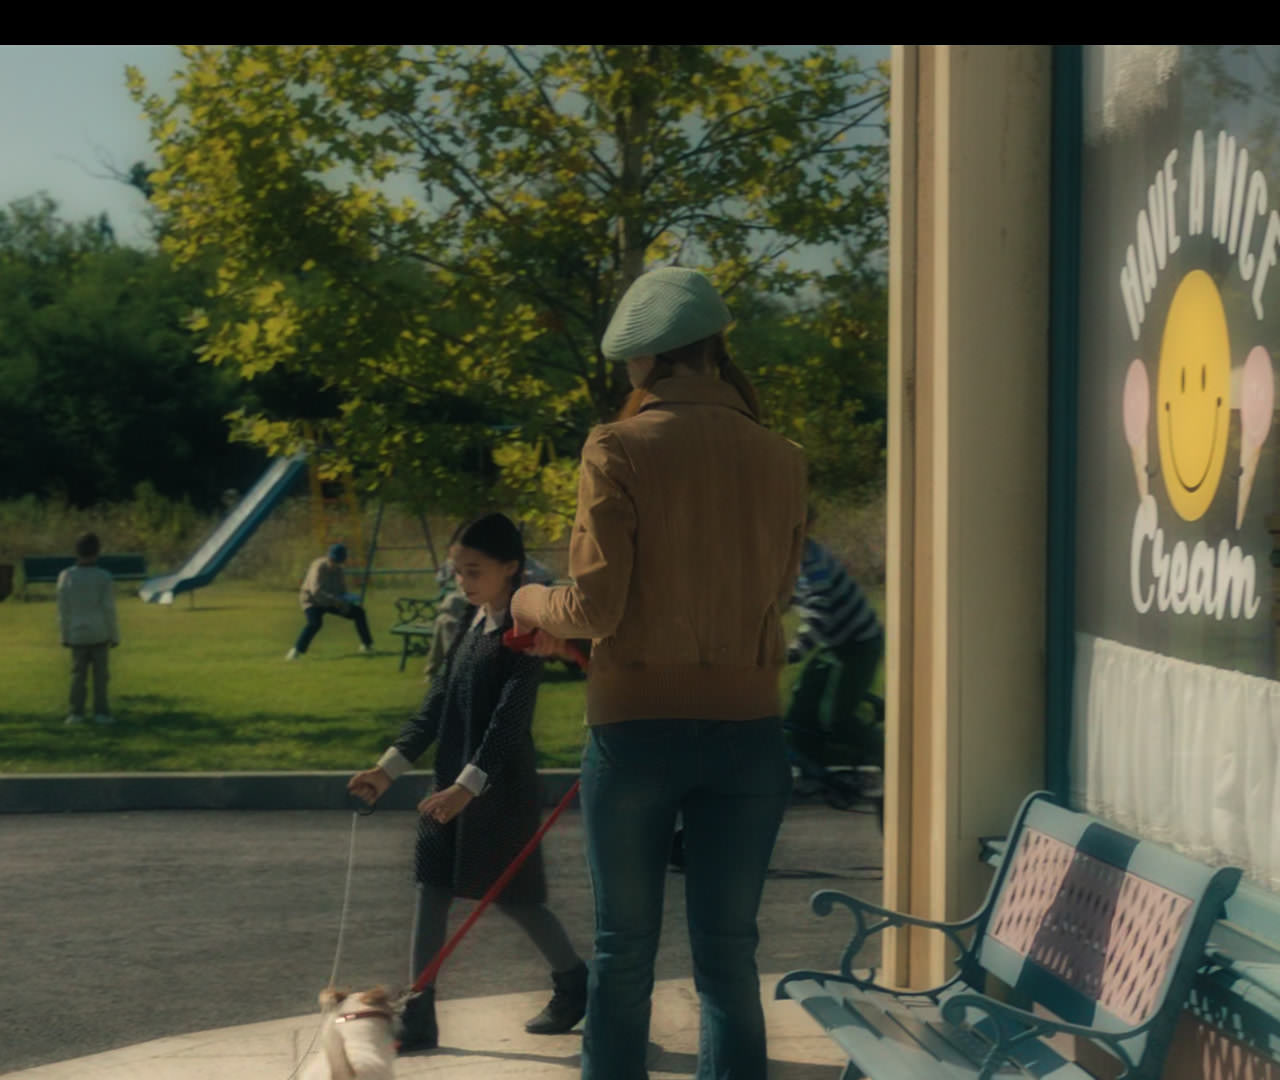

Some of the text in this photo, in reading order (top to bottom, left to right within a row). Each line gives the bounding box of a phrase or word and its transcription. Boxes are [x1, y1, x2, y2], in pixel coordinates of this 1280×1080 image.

[1121, 148, 1181, 341] HAVE
[1189, 129, 1206, 236] A
[1130, 494, 1262, 621] Cream
